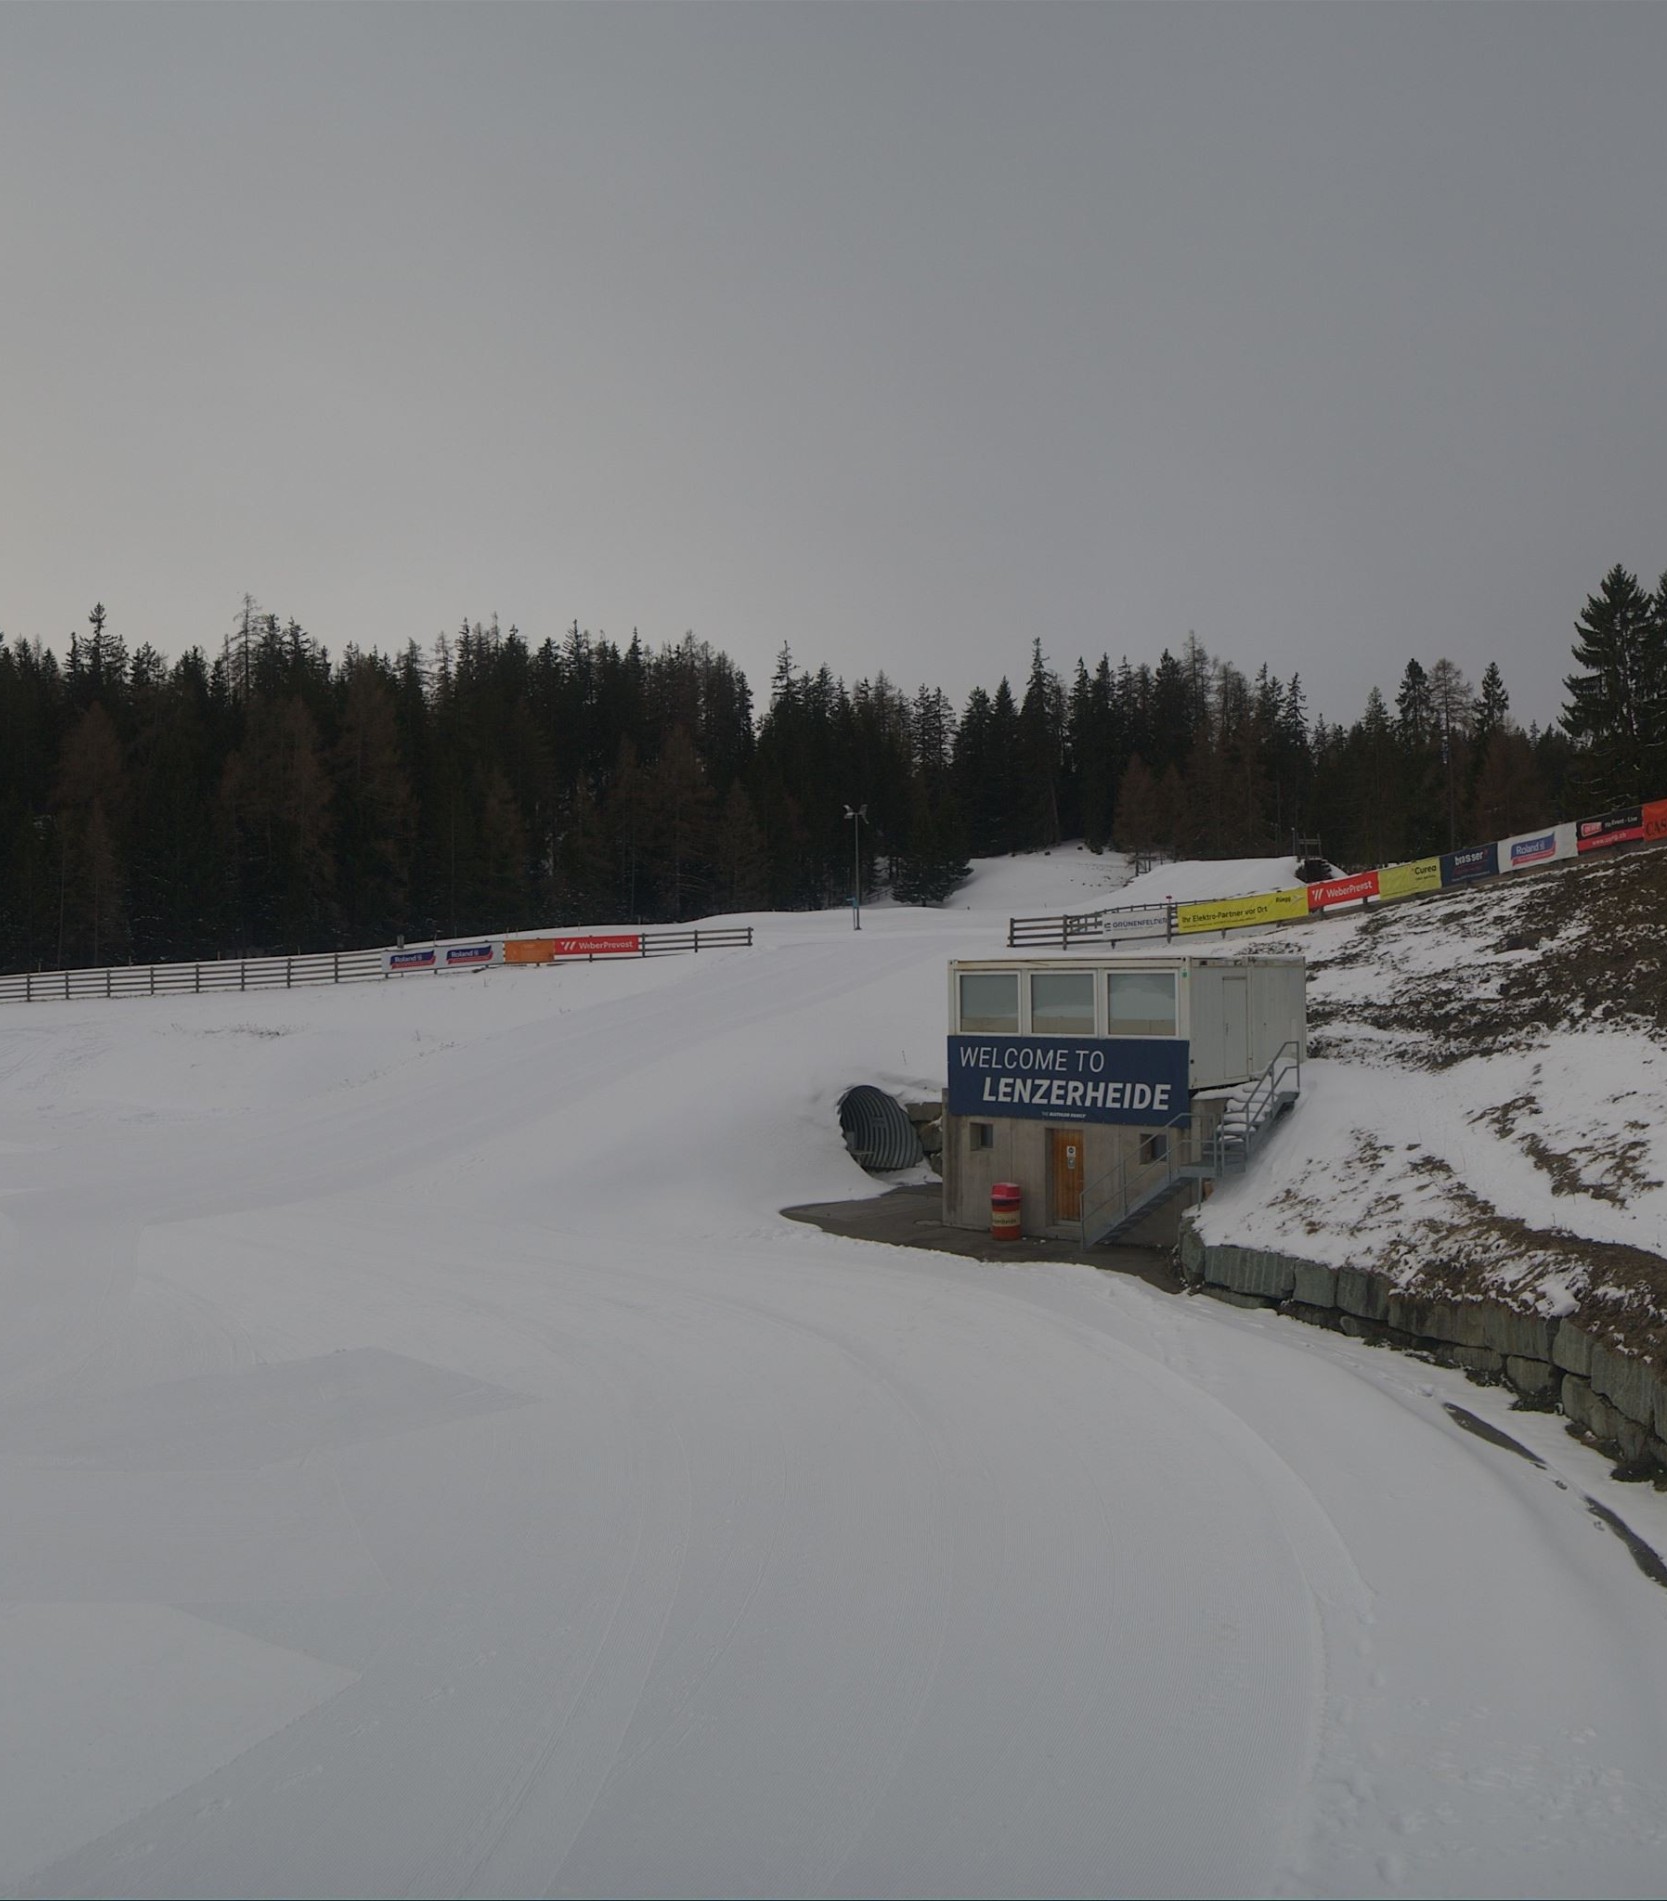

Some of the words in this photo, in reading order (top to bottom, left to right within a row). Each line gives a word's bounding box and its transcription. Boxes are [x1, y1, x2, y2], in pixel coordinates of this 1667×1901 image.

[1516, 844, 1540, 855] Roland
[1192, 910, 1243, 922] Elektro-Partner
[1257, 906, 1268, 914] Ort
[960, 1046, 1069, 1071] WELCOME
[1076, 1050, 1105, 1073] TO
[982, 1077, 1172, 1111] LENZERHEIDE
